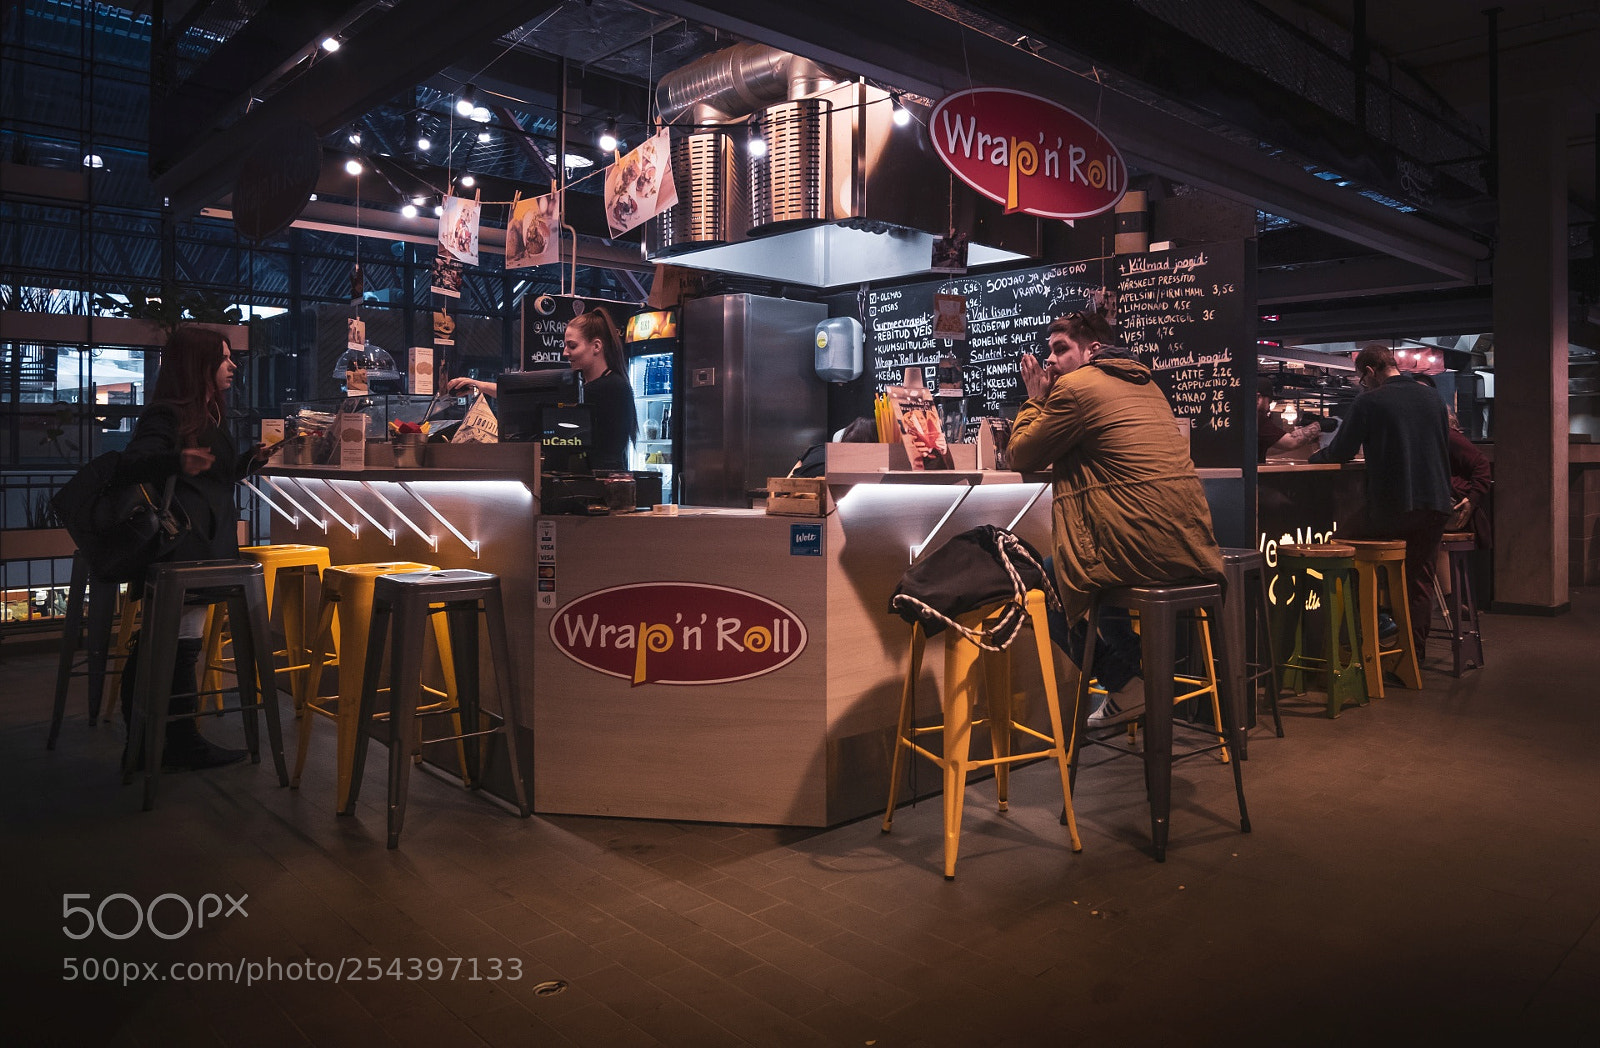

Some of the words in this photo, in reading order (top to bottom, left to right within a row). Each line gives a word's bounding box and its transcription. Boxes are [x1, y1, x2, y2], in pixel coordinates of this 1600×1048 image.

[1128, 256, 1170, 273] Külmad
[962, 283, 978, 294] 5,9€
[986, 274, 1024, 293] SOOJAD
[1028, 272, 1039, 284] JA
[1120, 276, 1156, 292] VÄRSKELT
[1158, 274, 1196, 286] PRESSITUD
[1212, 284, 1234, 296] 3,5€
[1174, 300, 1191, 311] 1,5€
[1014, 312, 1051, 328] KARTULID
[1202, 308, 1216, 321] 3€
[878, 328, 910, 342] REBITUD
[913, 324, 932, 338] VEIS
[1124, 327, 1145, 344] VESI
[972, 332, 1008, 348] ROHELINE
[1010, 332, 1038, 344] SALAT
[1152, 350, 1194, 370] Kuumad
[963, 370, 980, 383] 4,9€
[1176, 369, 1206, 382] LATTE
[964, 382, 980, 394] 3,9€
[986, 377, 1018, 388] KREEKA
[1230, 377, 1241, 388] 2€
[986, 388, 1007, 400] LÕHE
[1176, 392, 1206, 403] KAKAO
[1212, 390, 1225, 401] 2€
[1177, 405, 1202, 414] KOHV
[1210, 401, 1231, 414] 1,8€
[1208, 416, 1230, 431] 1,6€
[542, 436, 582, 446] uCash
